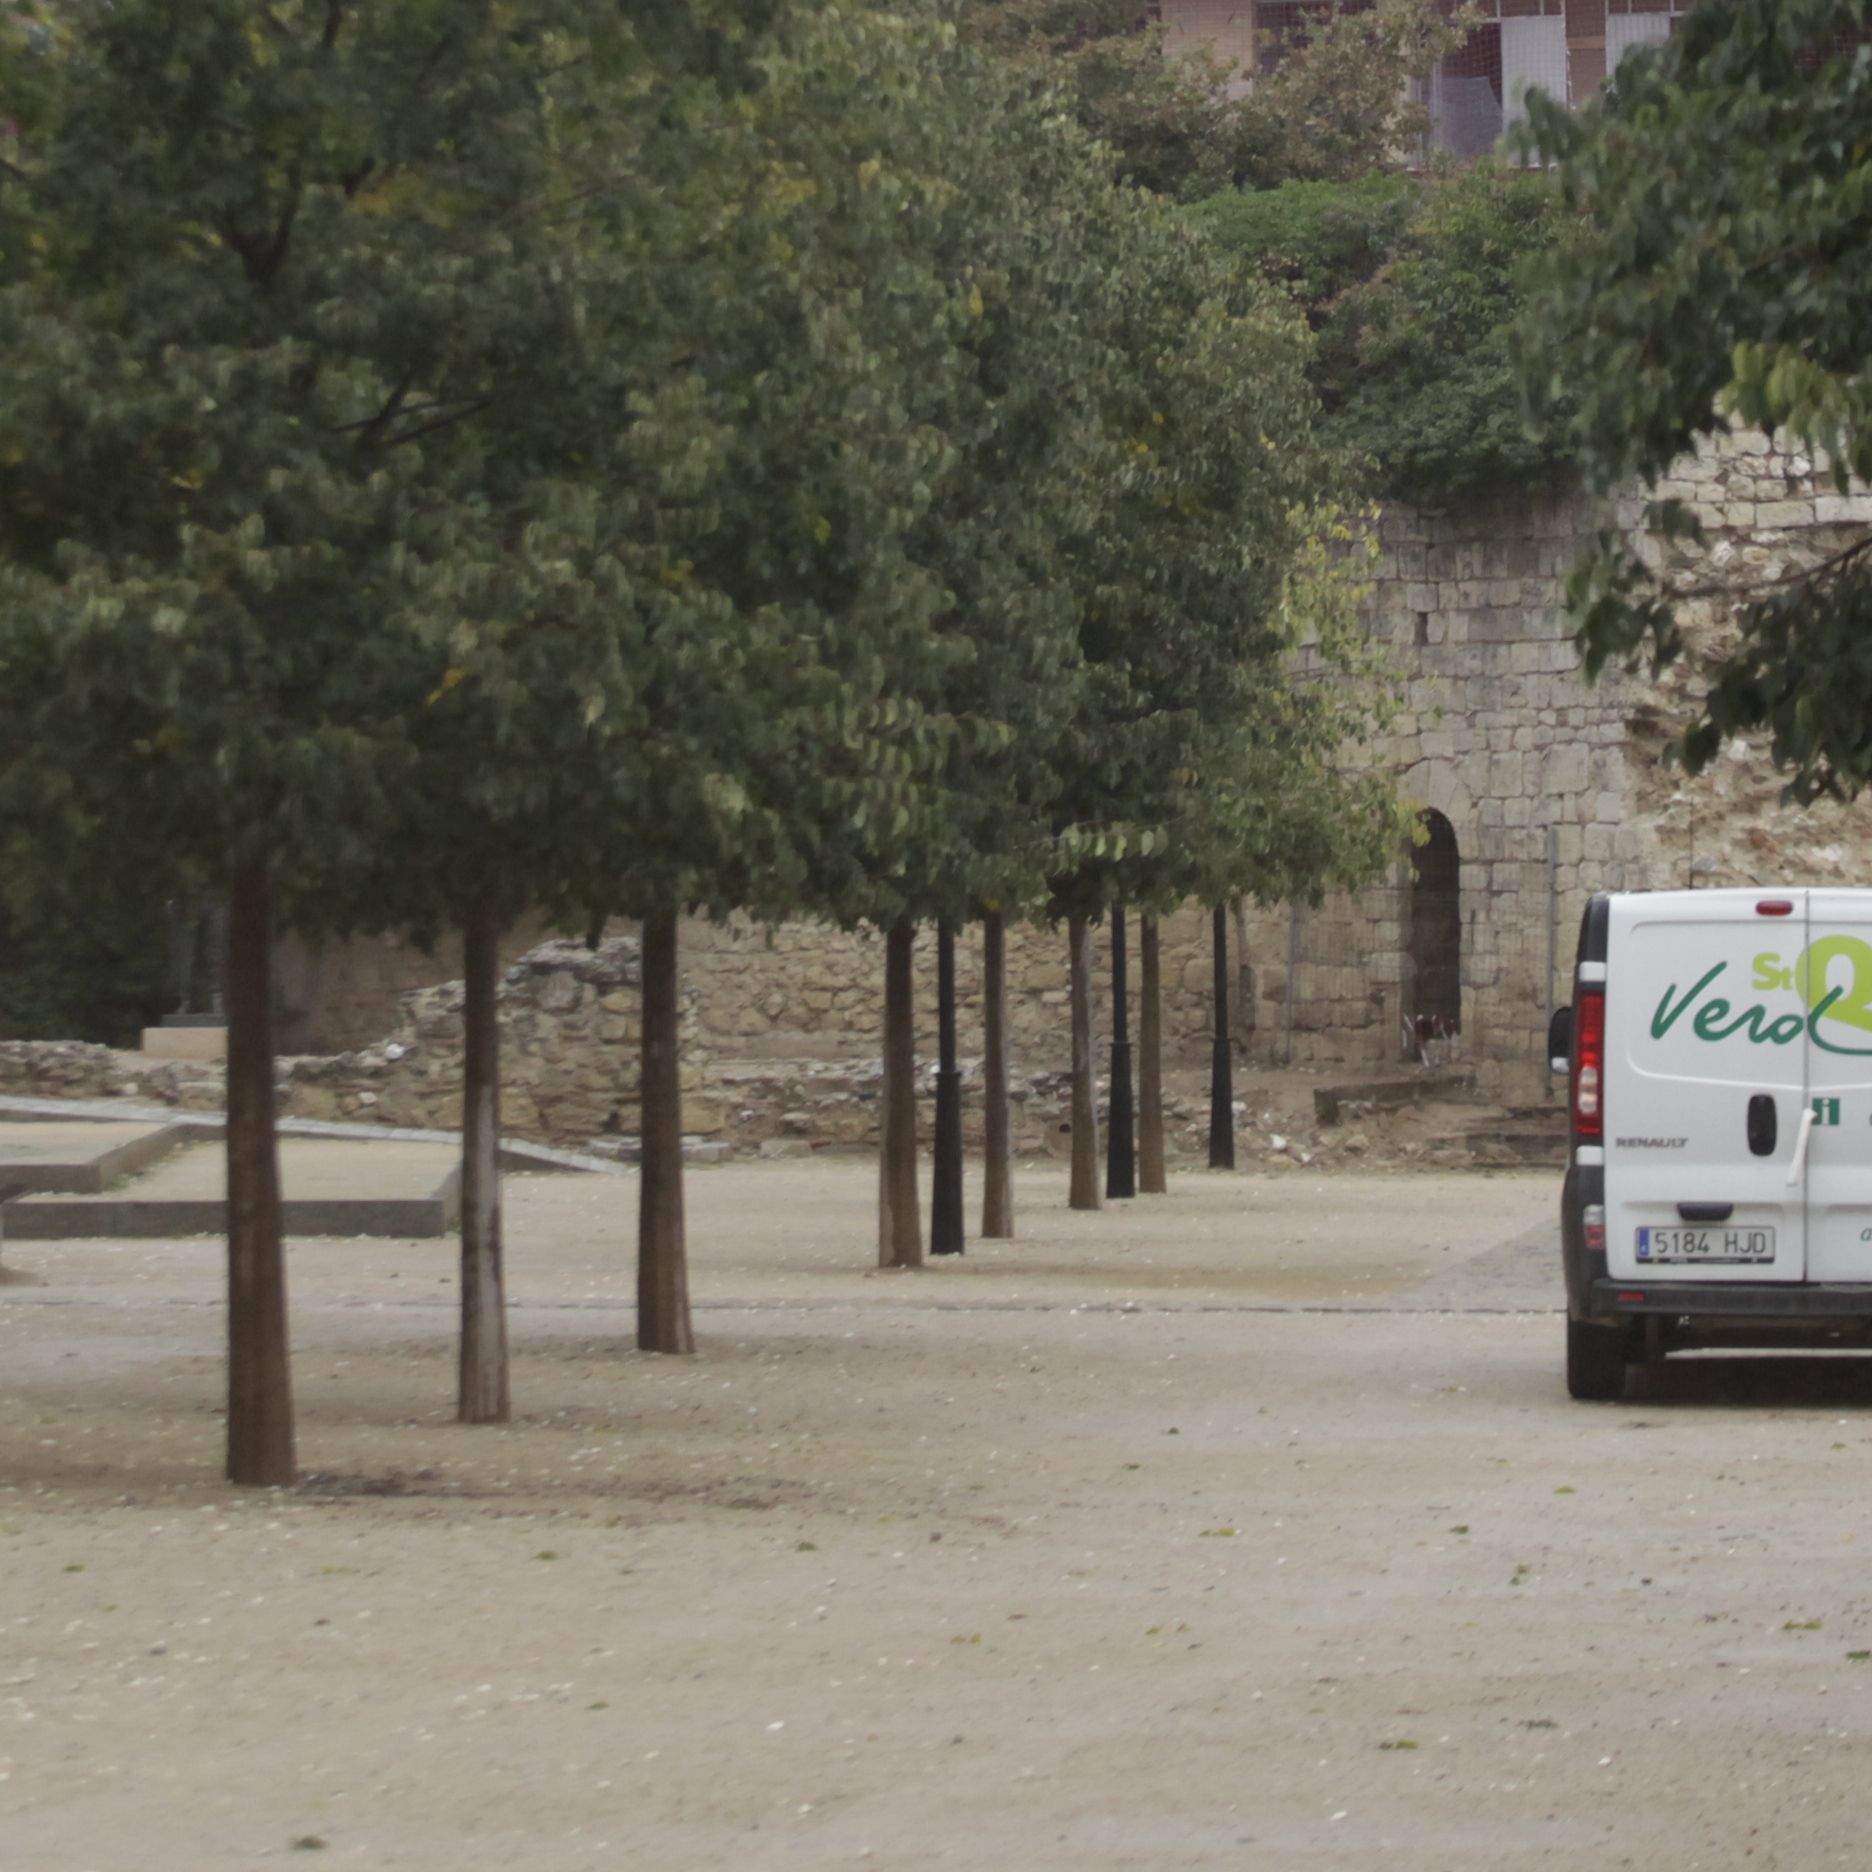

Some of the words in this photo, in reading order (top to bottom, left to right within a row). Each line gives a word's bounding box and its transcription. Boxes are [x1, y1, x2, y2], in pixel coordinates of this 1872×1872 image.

[1616, 1136, 1689, 1149] RENAULT
[1655, 1231, 1710, 1253] 5184
[1724, 1231, 1766, 1253] HJD
